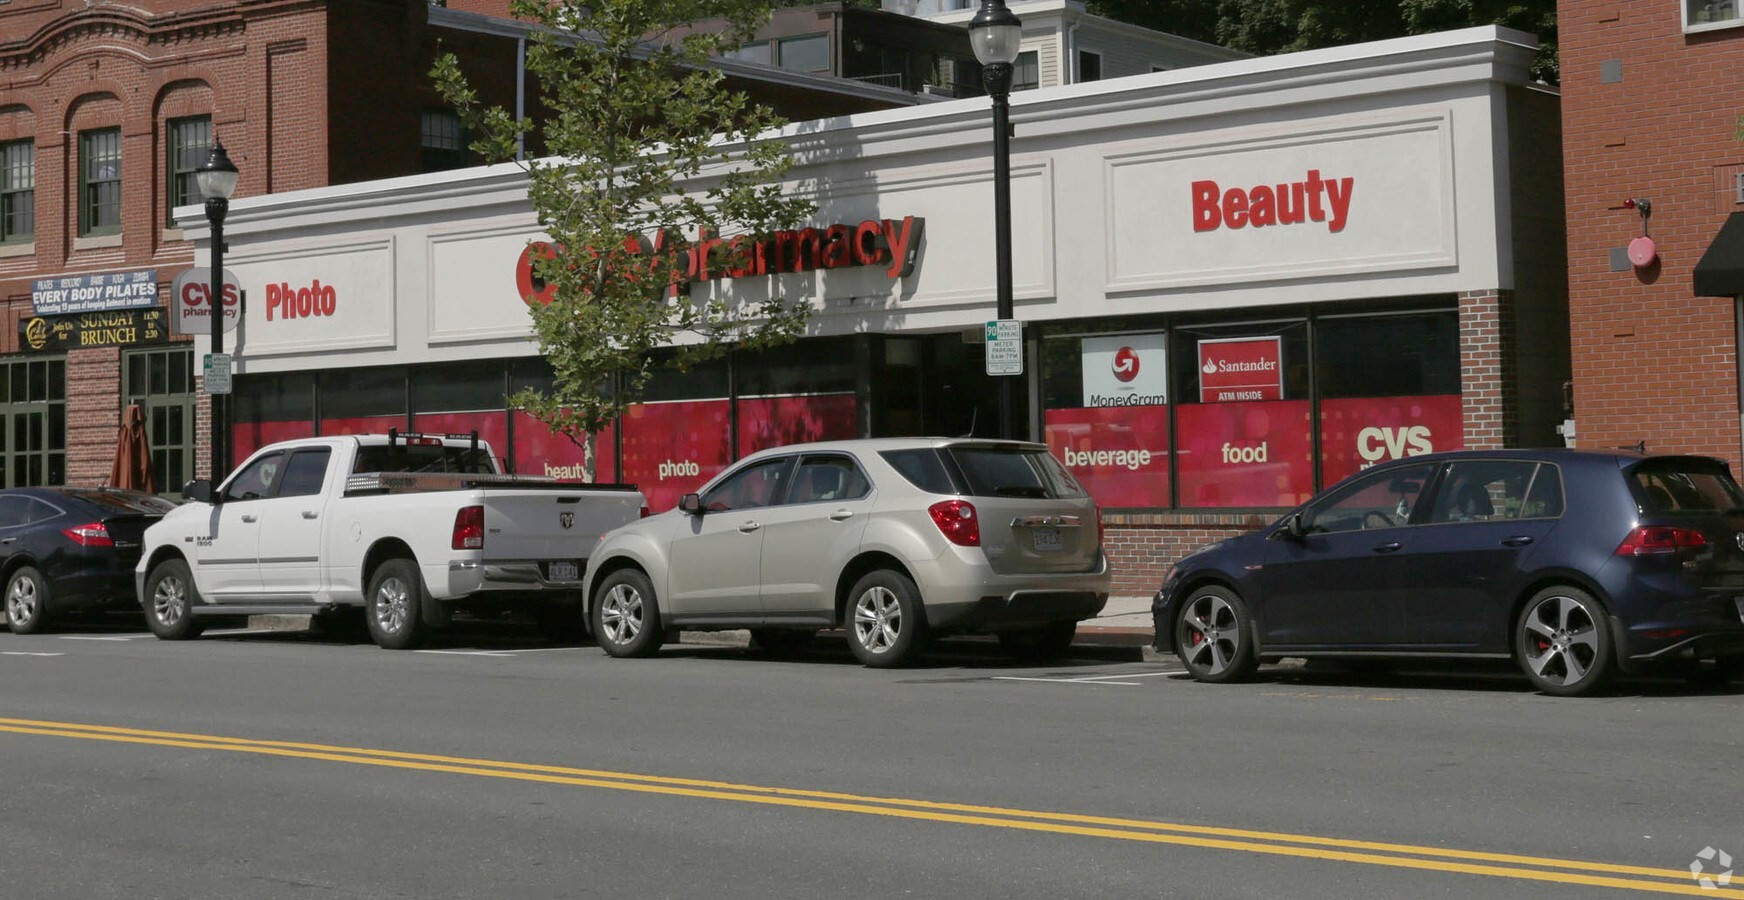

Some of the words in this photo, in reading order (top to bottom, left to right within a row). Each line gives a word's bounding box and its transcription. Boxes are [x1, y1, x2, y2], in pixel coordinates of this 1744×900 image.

[1191, 169, 1354, 233] Beauty
[33, 290, 69, 304] EVERY
[71, 288, 102, 301] BODY
[105, 282, 156, 298] PILATES
[181, 282, 238, 306] CVS
[266, 279, 336, 321] Photo
[80, 312, 134, 328] SUNDAY
[183, 307, 237, 319] pharcy
[81, 328, 136, 346] BRUNCH
[987, 326, 997, 336] 90
[1218, 357, 1276, 373] Santander
[1218, 391, 1235, 401] ATM
[1236, 390, 1262, 400] INSIDE
[1221, 442, 1267, 463] food
[1357, 425, 1433, 460] CVS
[1064, 447, 1150, 470] beverage
[659, 459, 699, 480] photo
